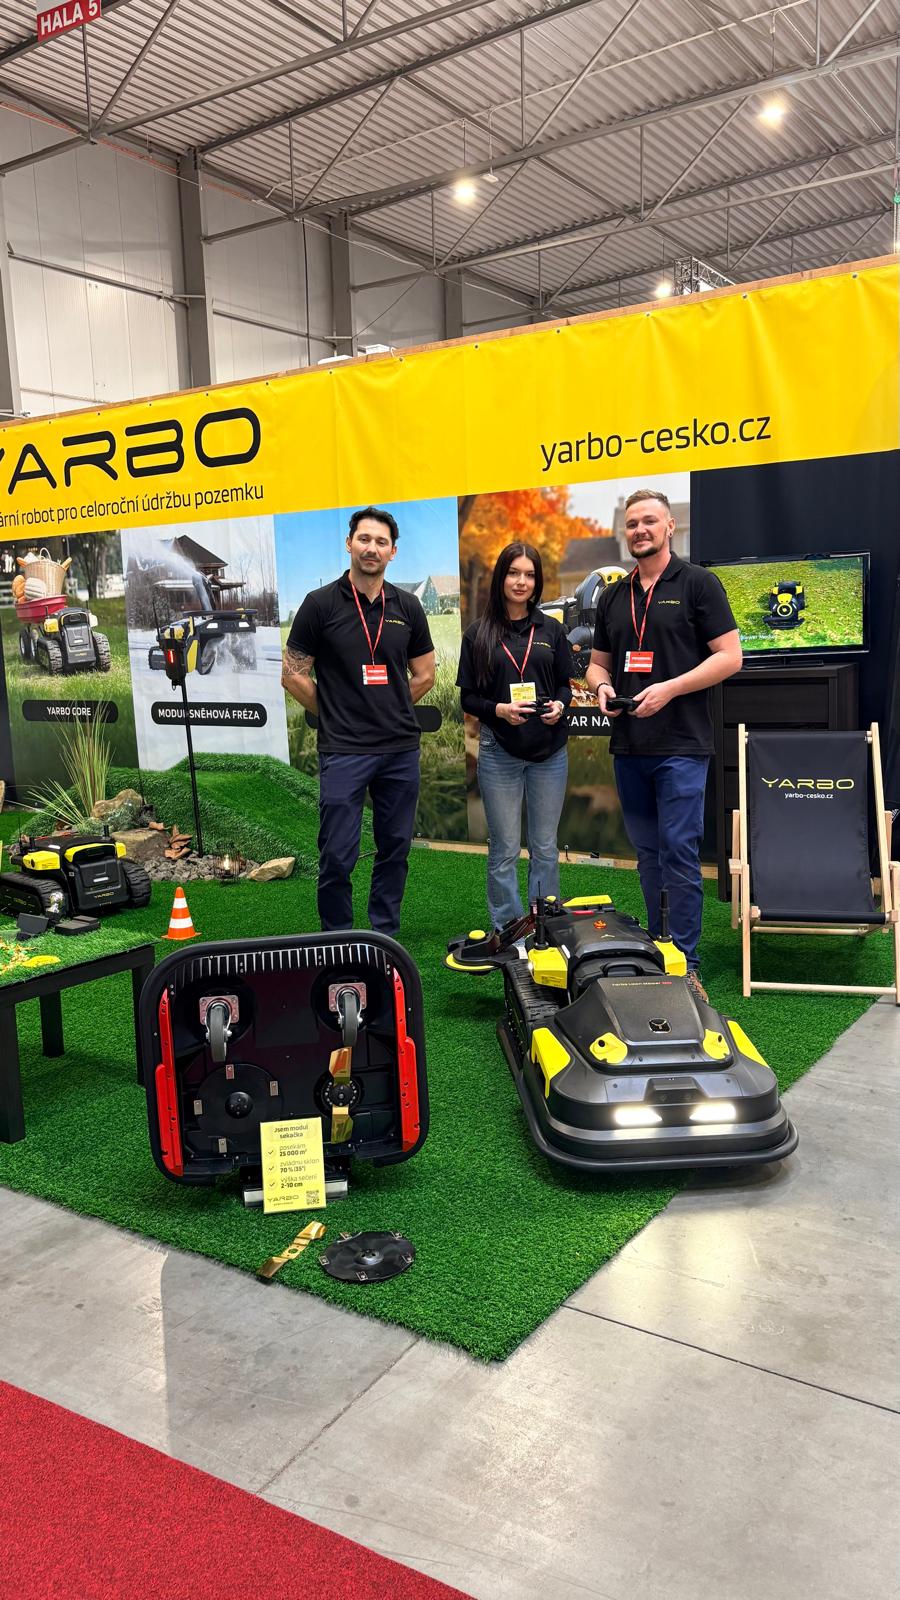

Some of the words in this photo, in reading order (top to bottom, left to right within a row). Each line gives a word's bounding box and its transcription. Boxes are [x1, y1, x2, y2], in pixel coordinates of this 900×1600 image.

[41, 2, 84, 36] HALA
[88, 0, 98, 17] 5
[541, 416, 771, 472] yarbo-cesko.cz
[0, 407, 261, 495] ARBO
[22, 508, 55, 526] robot
[57, 507, 78, 524] pro
[80, 495, 139, 519] celoroční
[142, 491, 191, 512] údržbu
[194, 482, 264, 509] pozemku
[46, 706, 71, 716] YARBO
[72, 707, 92, 716] CORE
[189, 708, 231, 719] SNĚHOVÁ
[232, 708, 260, 720] FRÉZA
[591, 715, 611, 727] NA
[761, 777, 855, 790] YARBO
[290, 1124, 308, 1132] modul
